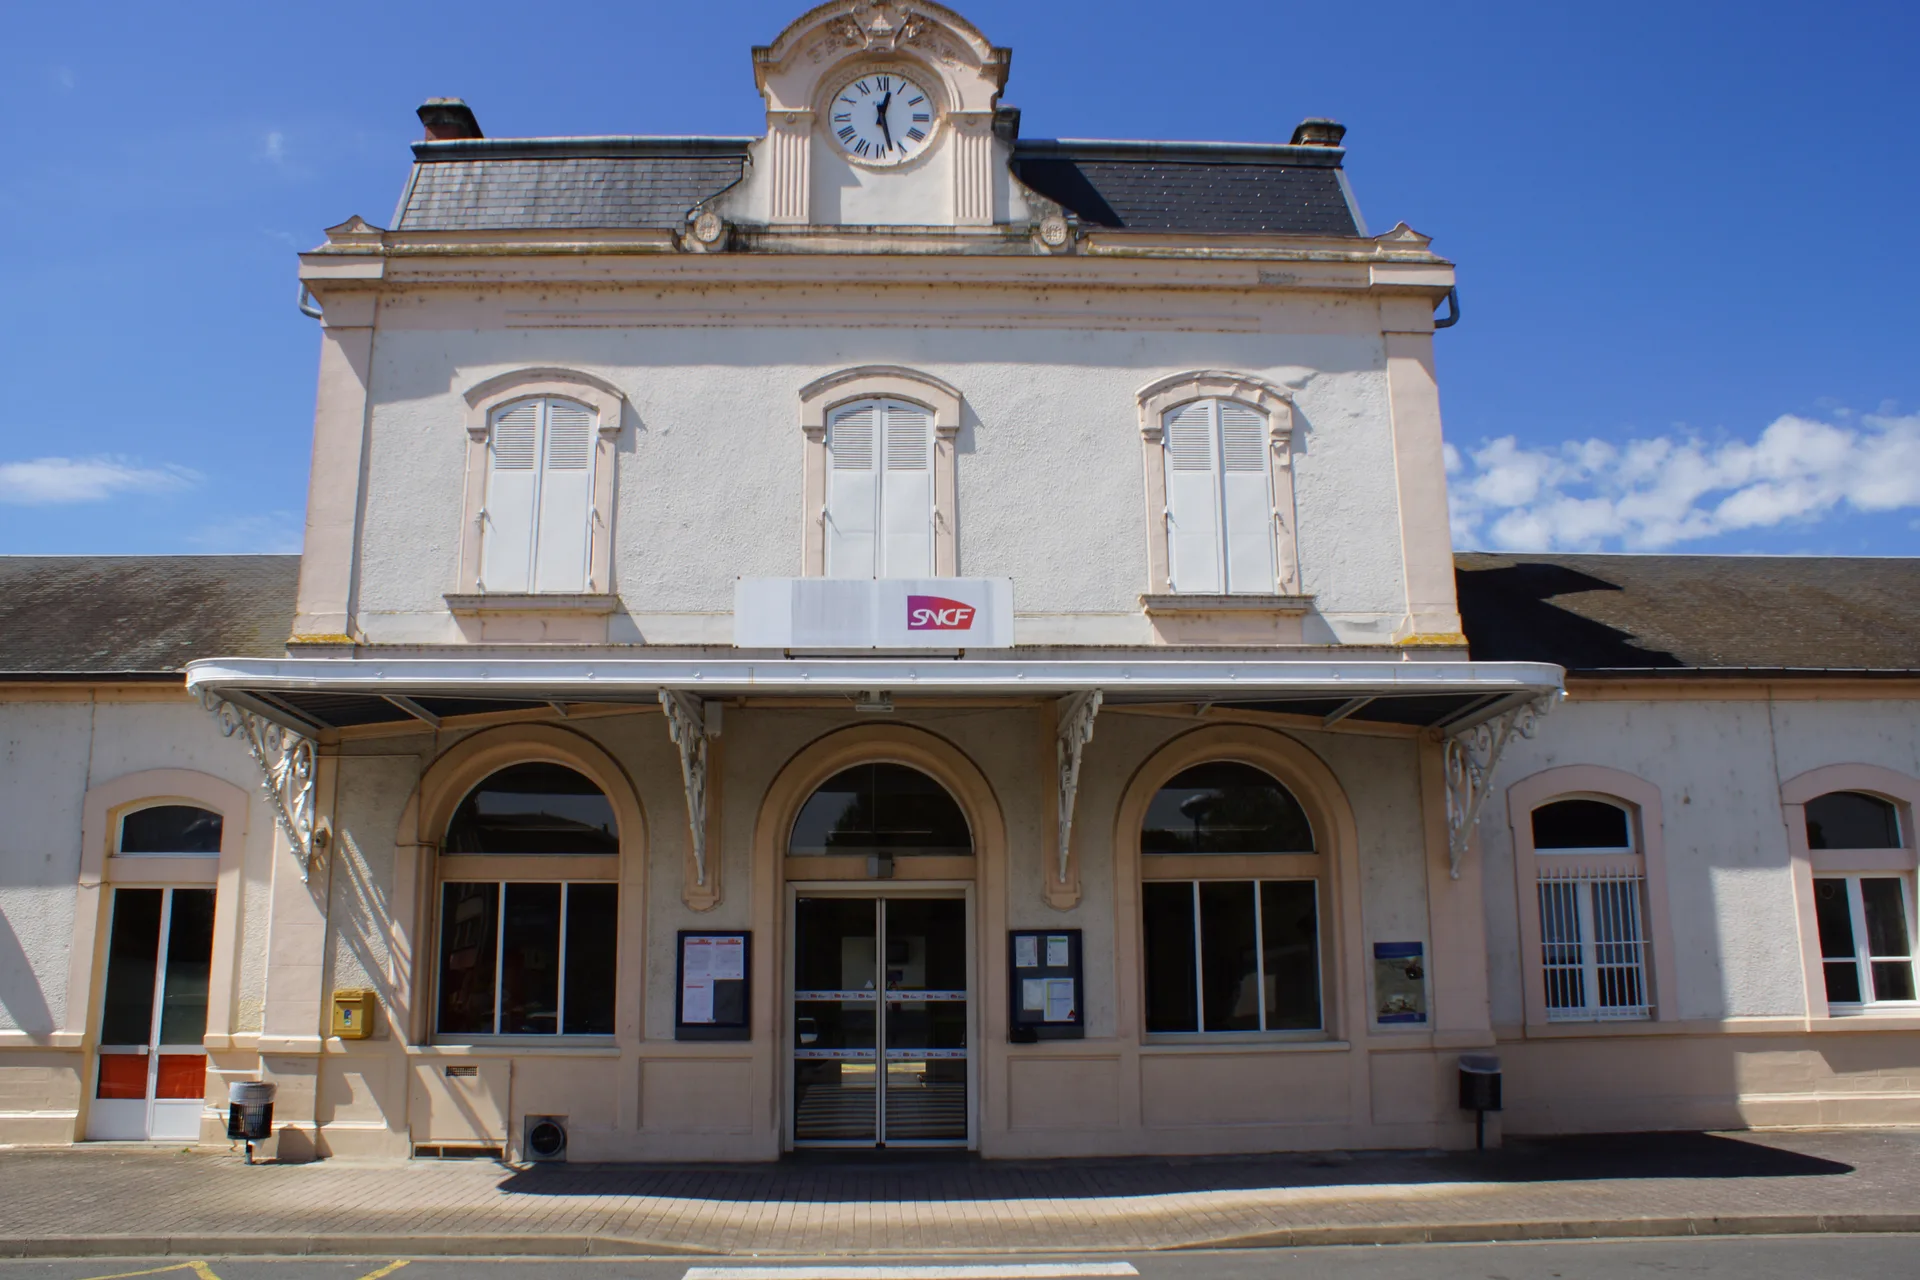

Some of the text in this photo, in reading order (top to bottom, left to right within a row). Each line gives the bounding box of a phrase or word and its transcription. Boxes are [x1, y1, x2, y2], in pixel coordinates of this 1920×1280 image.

[855, 80, 871, 96] XI
[876, 77, 889, 91] XII
[840, 95, 857, 106] X
[908, 95, 924, 106] II
[834, 113, 851, 122] IX
[912, 113, 929, 122] III
[837, 125, 857, 145] VIII
[906, 126, 926, 143] IIII
[854, 138, 871, 157] VII
[876, 144, 886, 159] VI
[910, 608, 972, 626] SNCF
